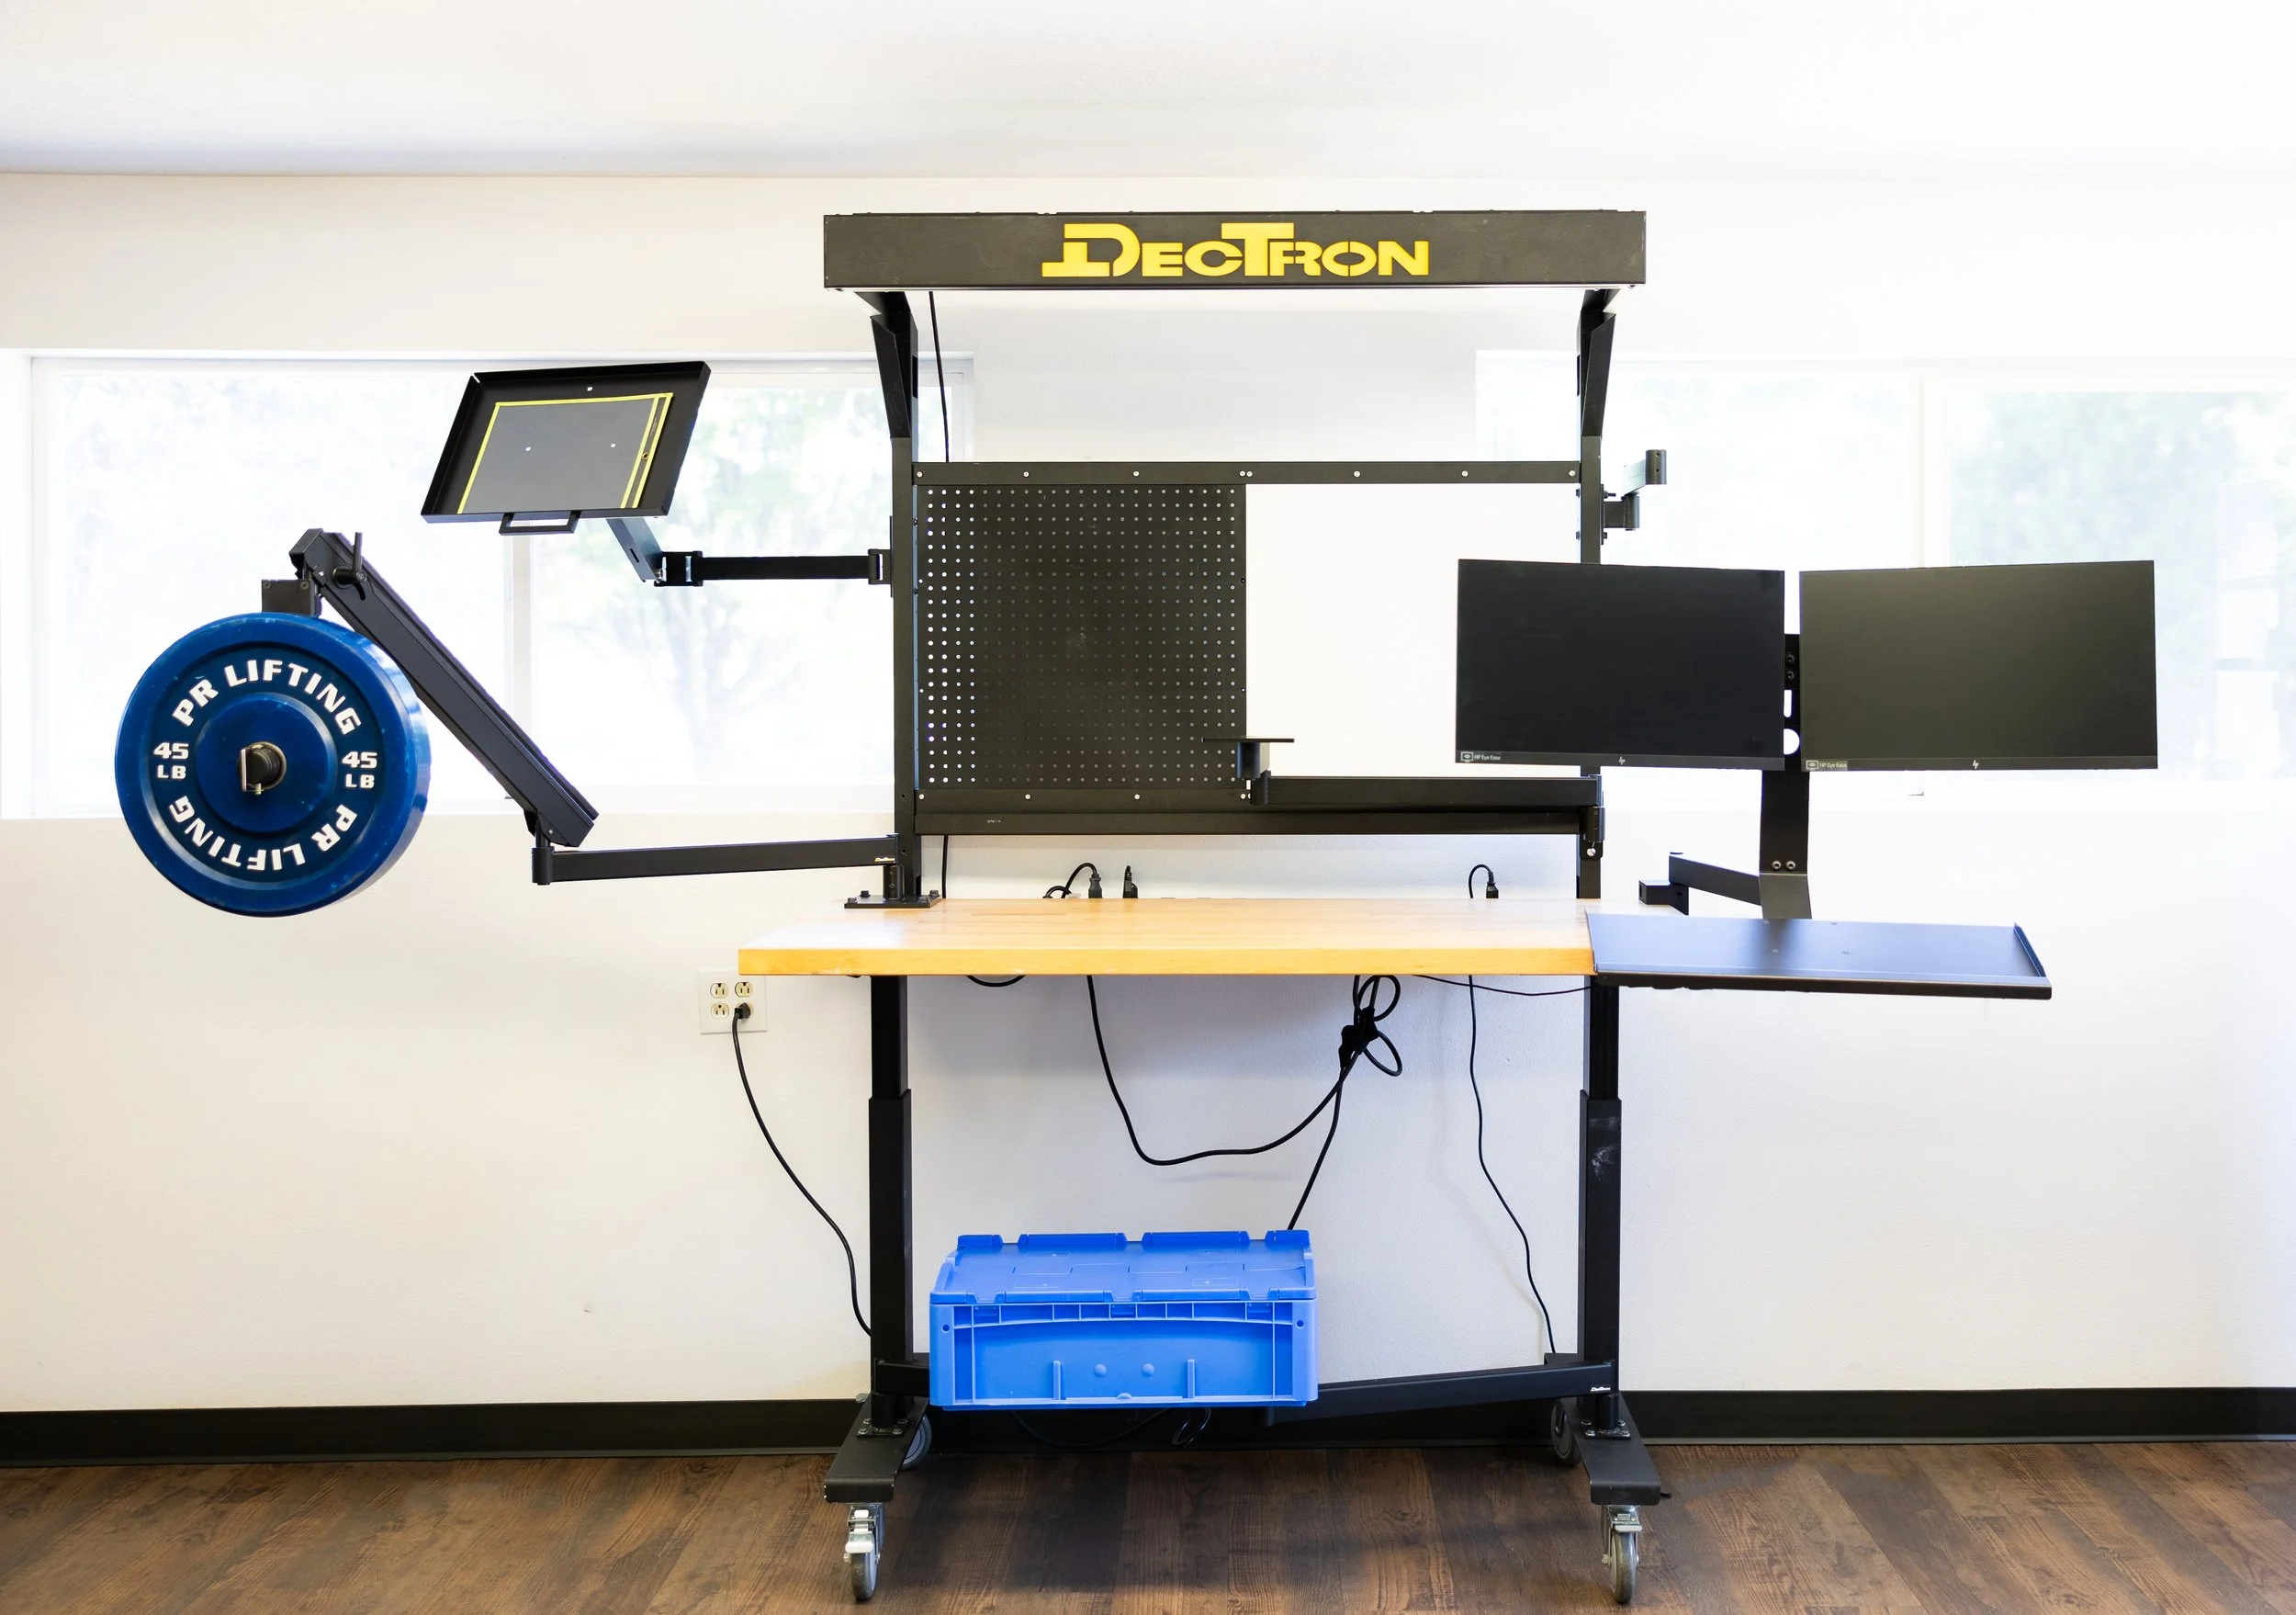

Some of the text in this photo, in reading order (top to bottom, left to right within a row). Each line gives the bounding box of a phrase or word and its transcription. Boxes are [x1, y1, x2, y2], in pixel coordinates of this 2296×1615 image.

[173, 660, 362, 735] PR LIFTING
[153, 741, 189, 760] 45
[342, 751, 378, 769] 45
[157, 764, 186, 779] LB
[345, 774, 375, 789] LB
[169, 796, 358, 871] PR LIFTING
